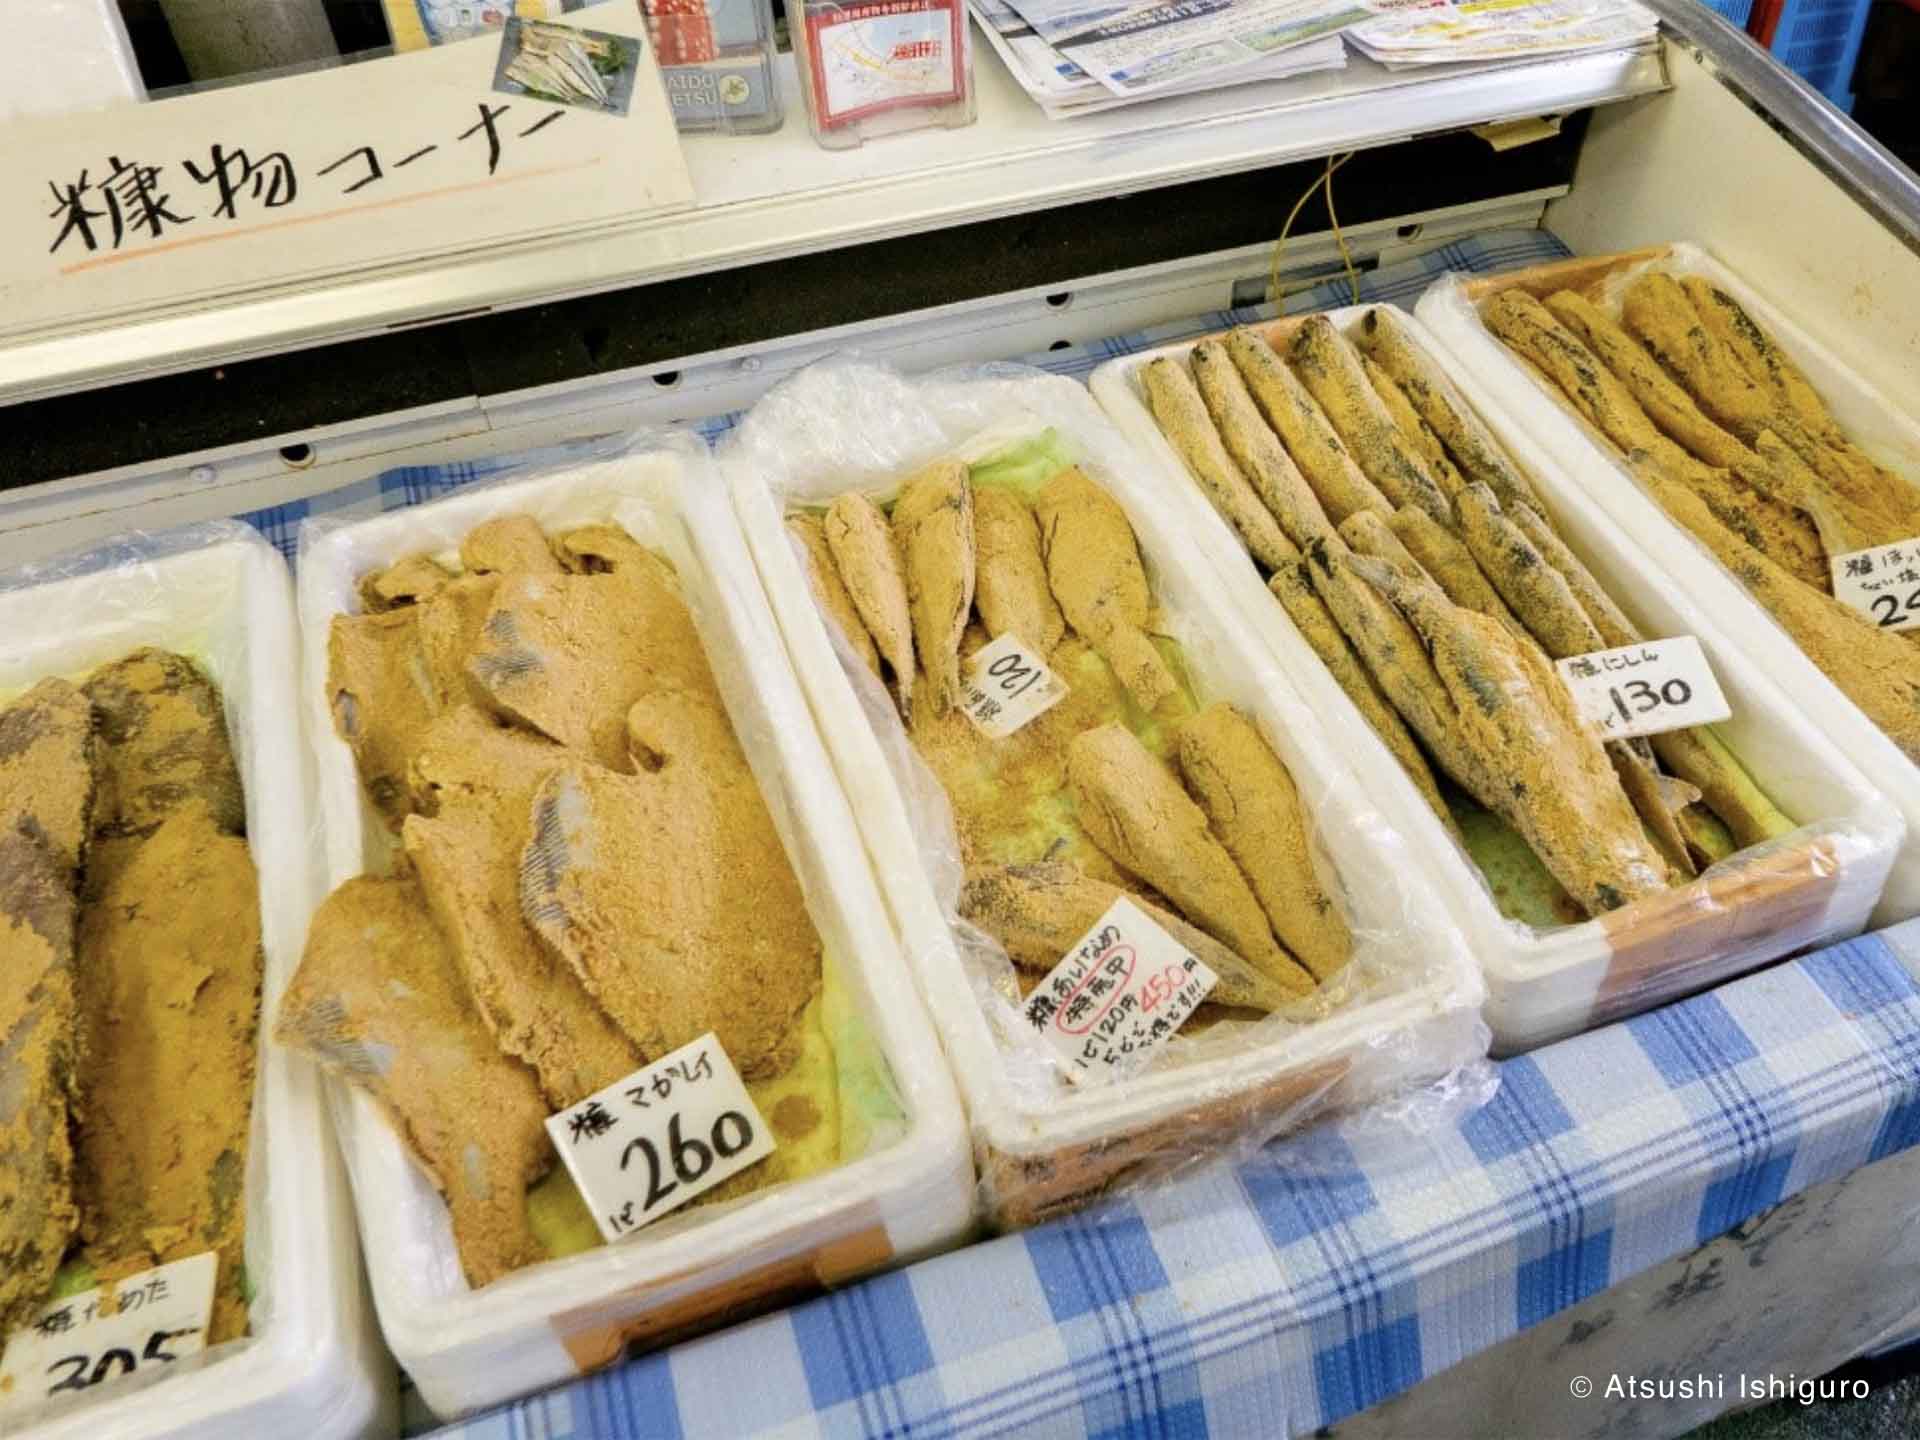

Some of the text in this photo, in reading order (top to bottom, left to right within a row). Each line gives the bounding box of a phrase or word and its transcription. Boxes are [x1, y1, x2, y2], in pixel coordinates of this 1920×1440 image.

[49, 102, 566, 254] 糠物コーナー
[1609, 678, 1692, 724] 130
[620, 1109, 754, 1212] 260
